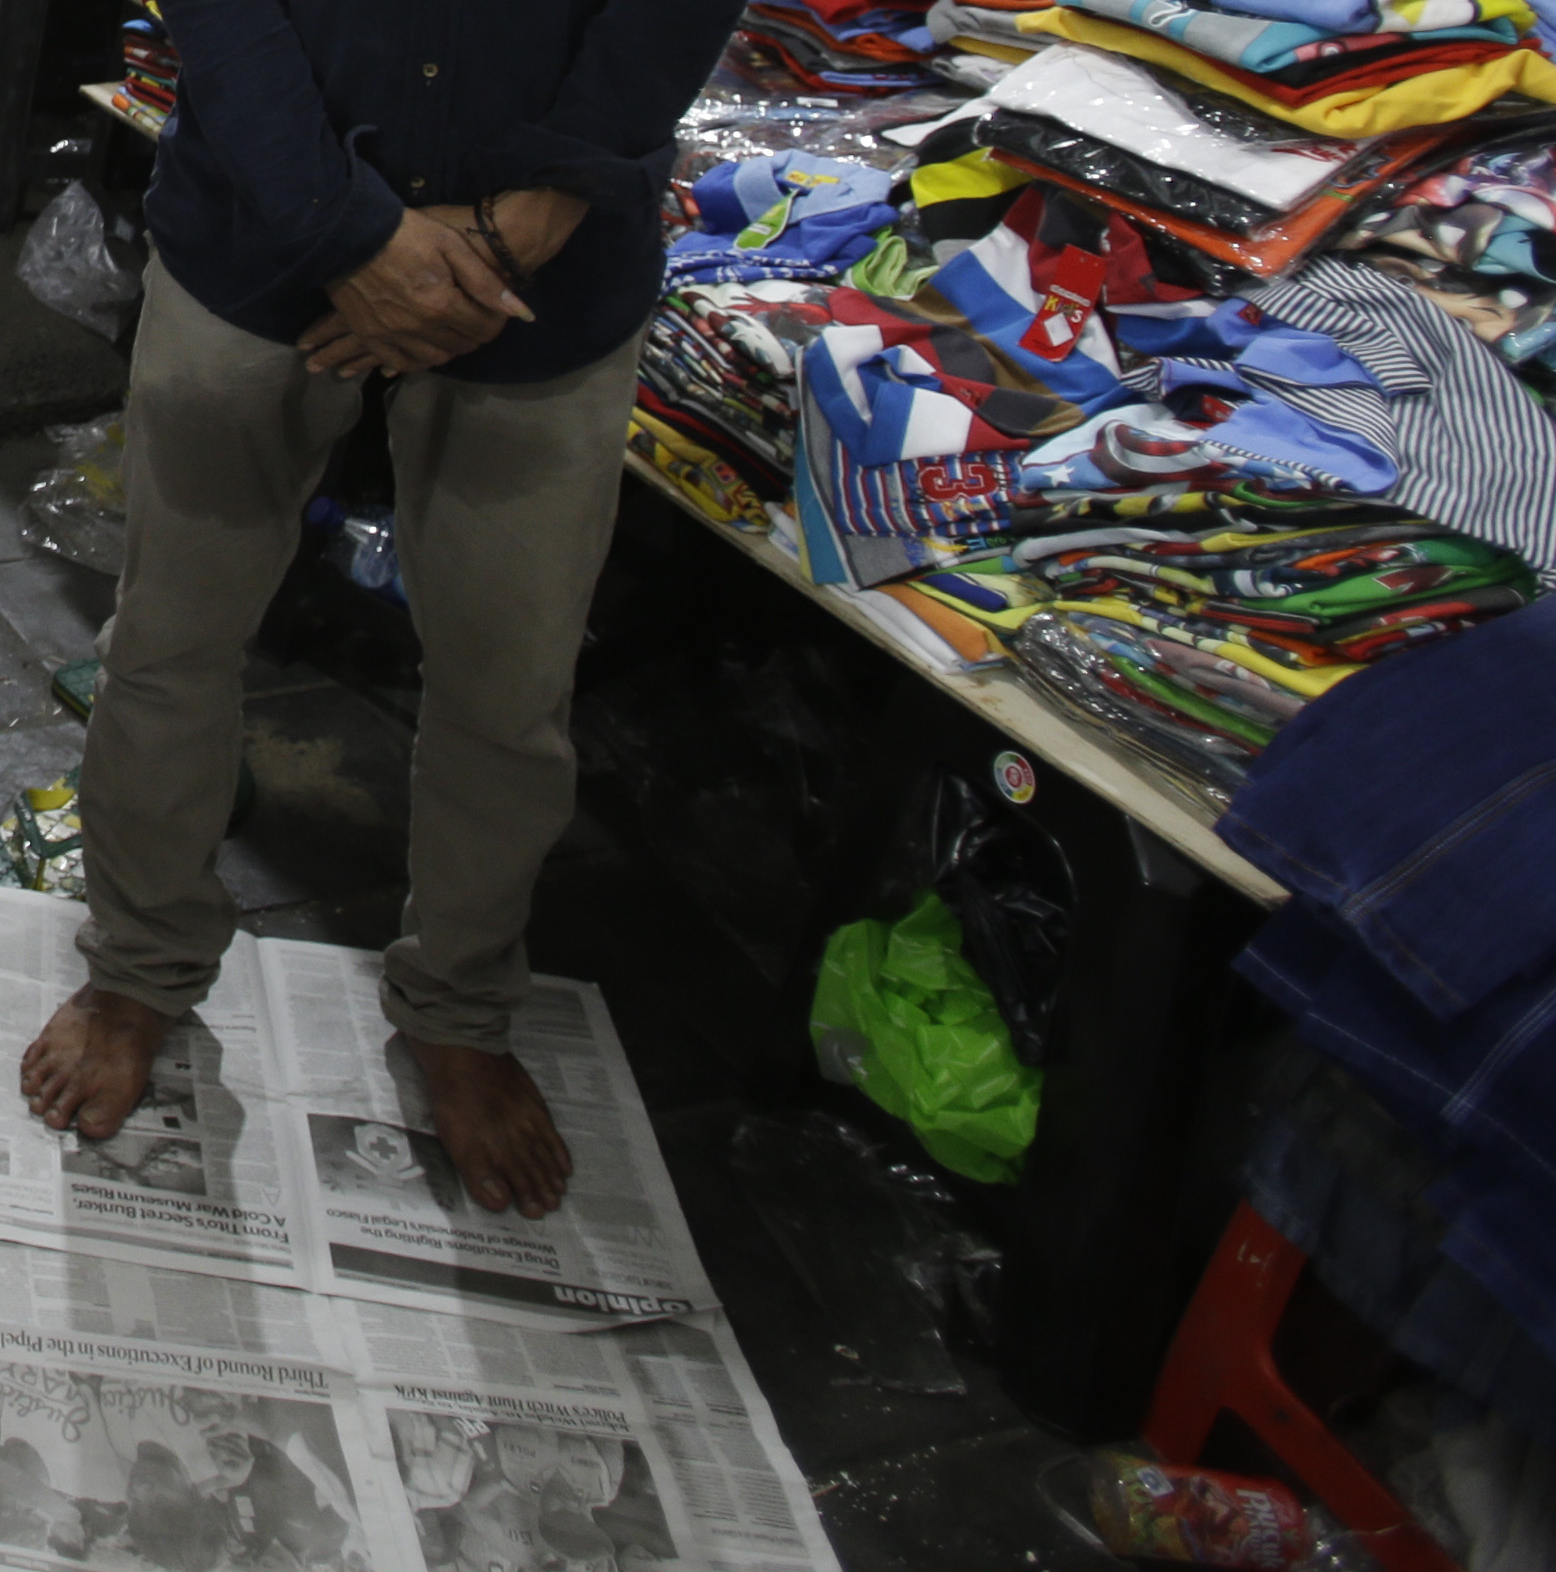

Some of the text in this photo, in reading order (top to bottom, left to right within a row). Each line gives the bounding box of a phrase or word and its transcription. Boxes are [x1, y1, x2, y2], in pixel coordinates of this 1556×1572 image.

[71, 1183, 115, 1200] Rises
[116, 1191, 193, 1213] Museum
[196, 1202, 231, 1219] War
[72, 1198, 290, 1245] From Tito's Secret Bunker,
[231, 1208, 270, 1226] Cold
[272, 1214, 287, 1228] A
[325, 1208, 557, 1256] Wrongs of Indonesia's Legal Fiasco
[360, 1226, 383, 1239] the
[383, 1227, 443, 1250] Righting
[524, 1251, 561, 1270] Drug
[46, 1338, 75, 1359] the
[77, 1342, 95, 1361] in
[97, 1343, 193, 1372] Executions
[194, 1356, 214, 1376] of
[217, 1359, 275, 1383] Round
[278, 1366, 328, 1389] Third
[431, 1389, 485, 1408] Against
[486, 1395, 525, 1413] Hunt
[526, 1399, 571, 1418] Witch
[573, 1405, 628, 1425] Police's
